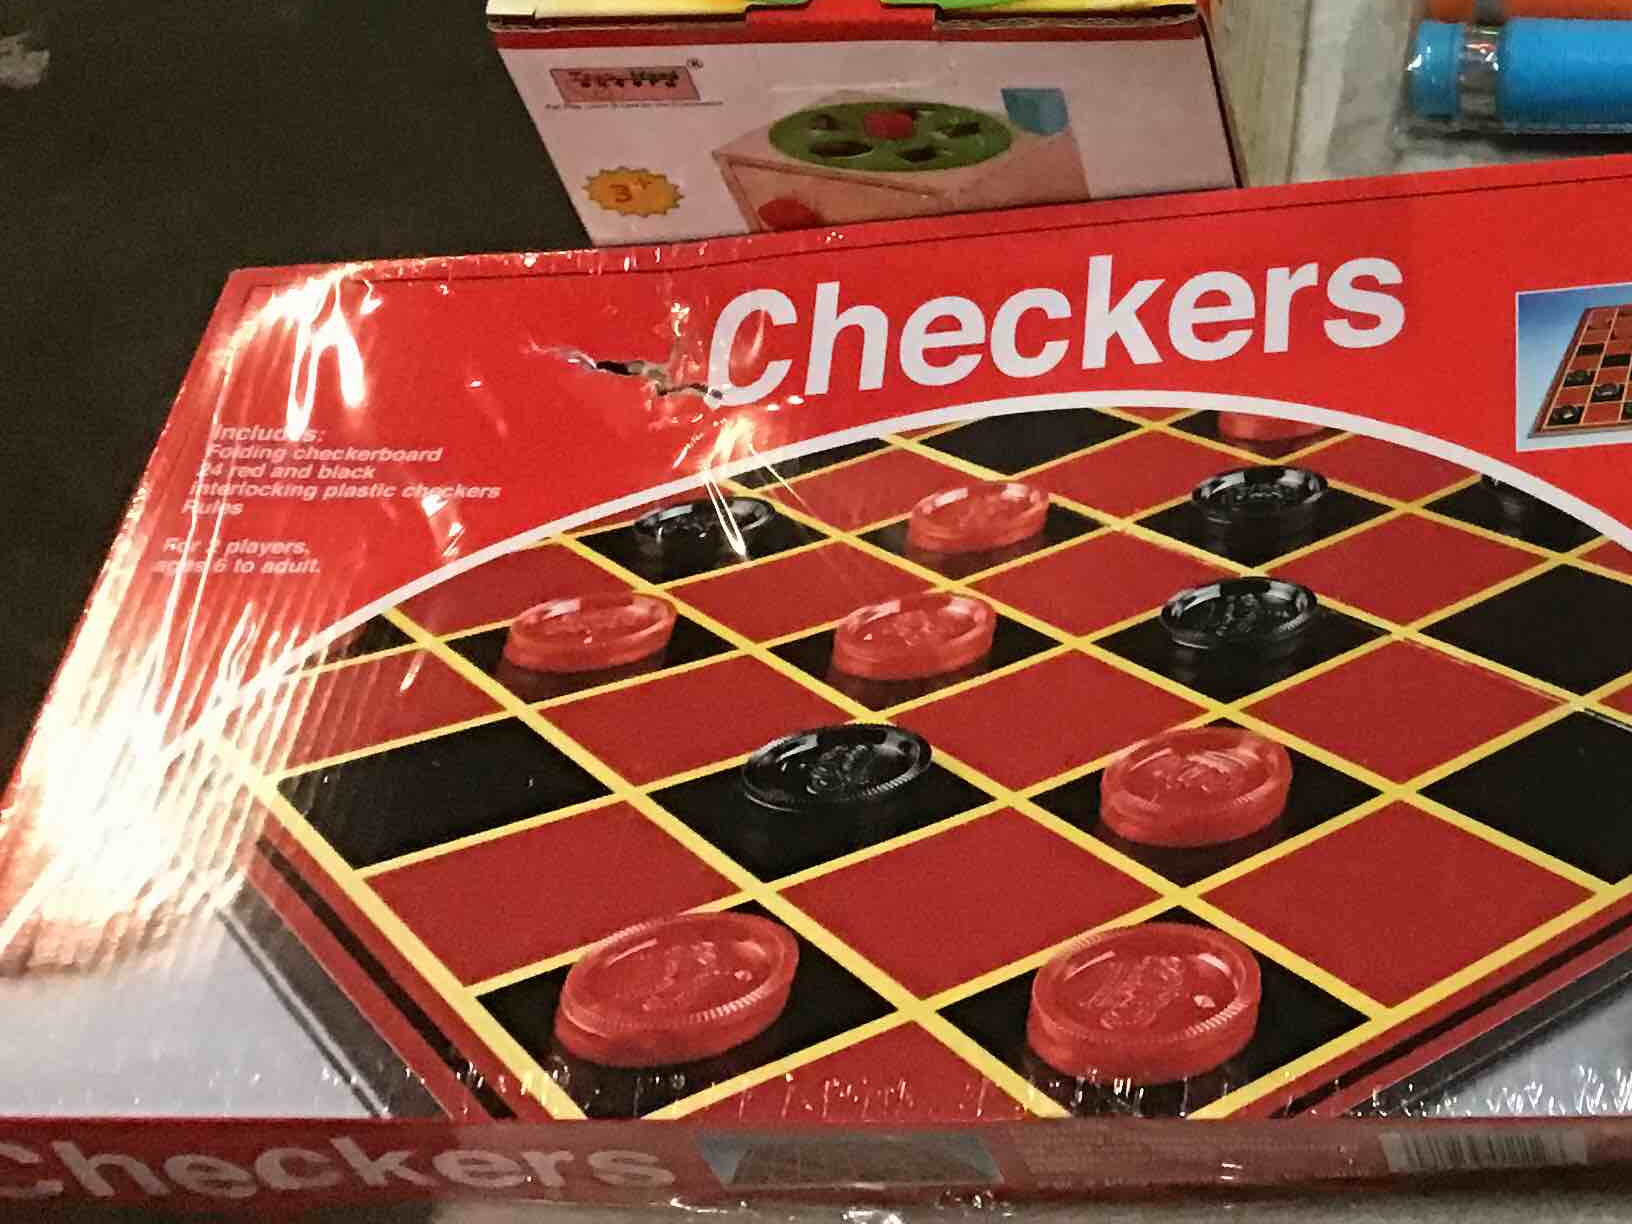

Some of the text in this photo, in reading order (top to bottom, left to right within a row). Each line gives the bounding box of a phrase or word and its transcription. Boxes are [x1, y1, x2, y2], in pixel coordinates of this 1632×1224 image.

[704, 254, 1406, 410] Checkers
[208, 443, 444, 464] Folding checkerboard
[229, 462, 267, 478] red
[271, 462, 314, 479] and
[318, 462, 376, 480] black
[322, 482, 397, 501] plastic
[401, 482, 503, 499] checkers
[233, 558, 256, 574] to
[261, 556, 321, 574] adult.
